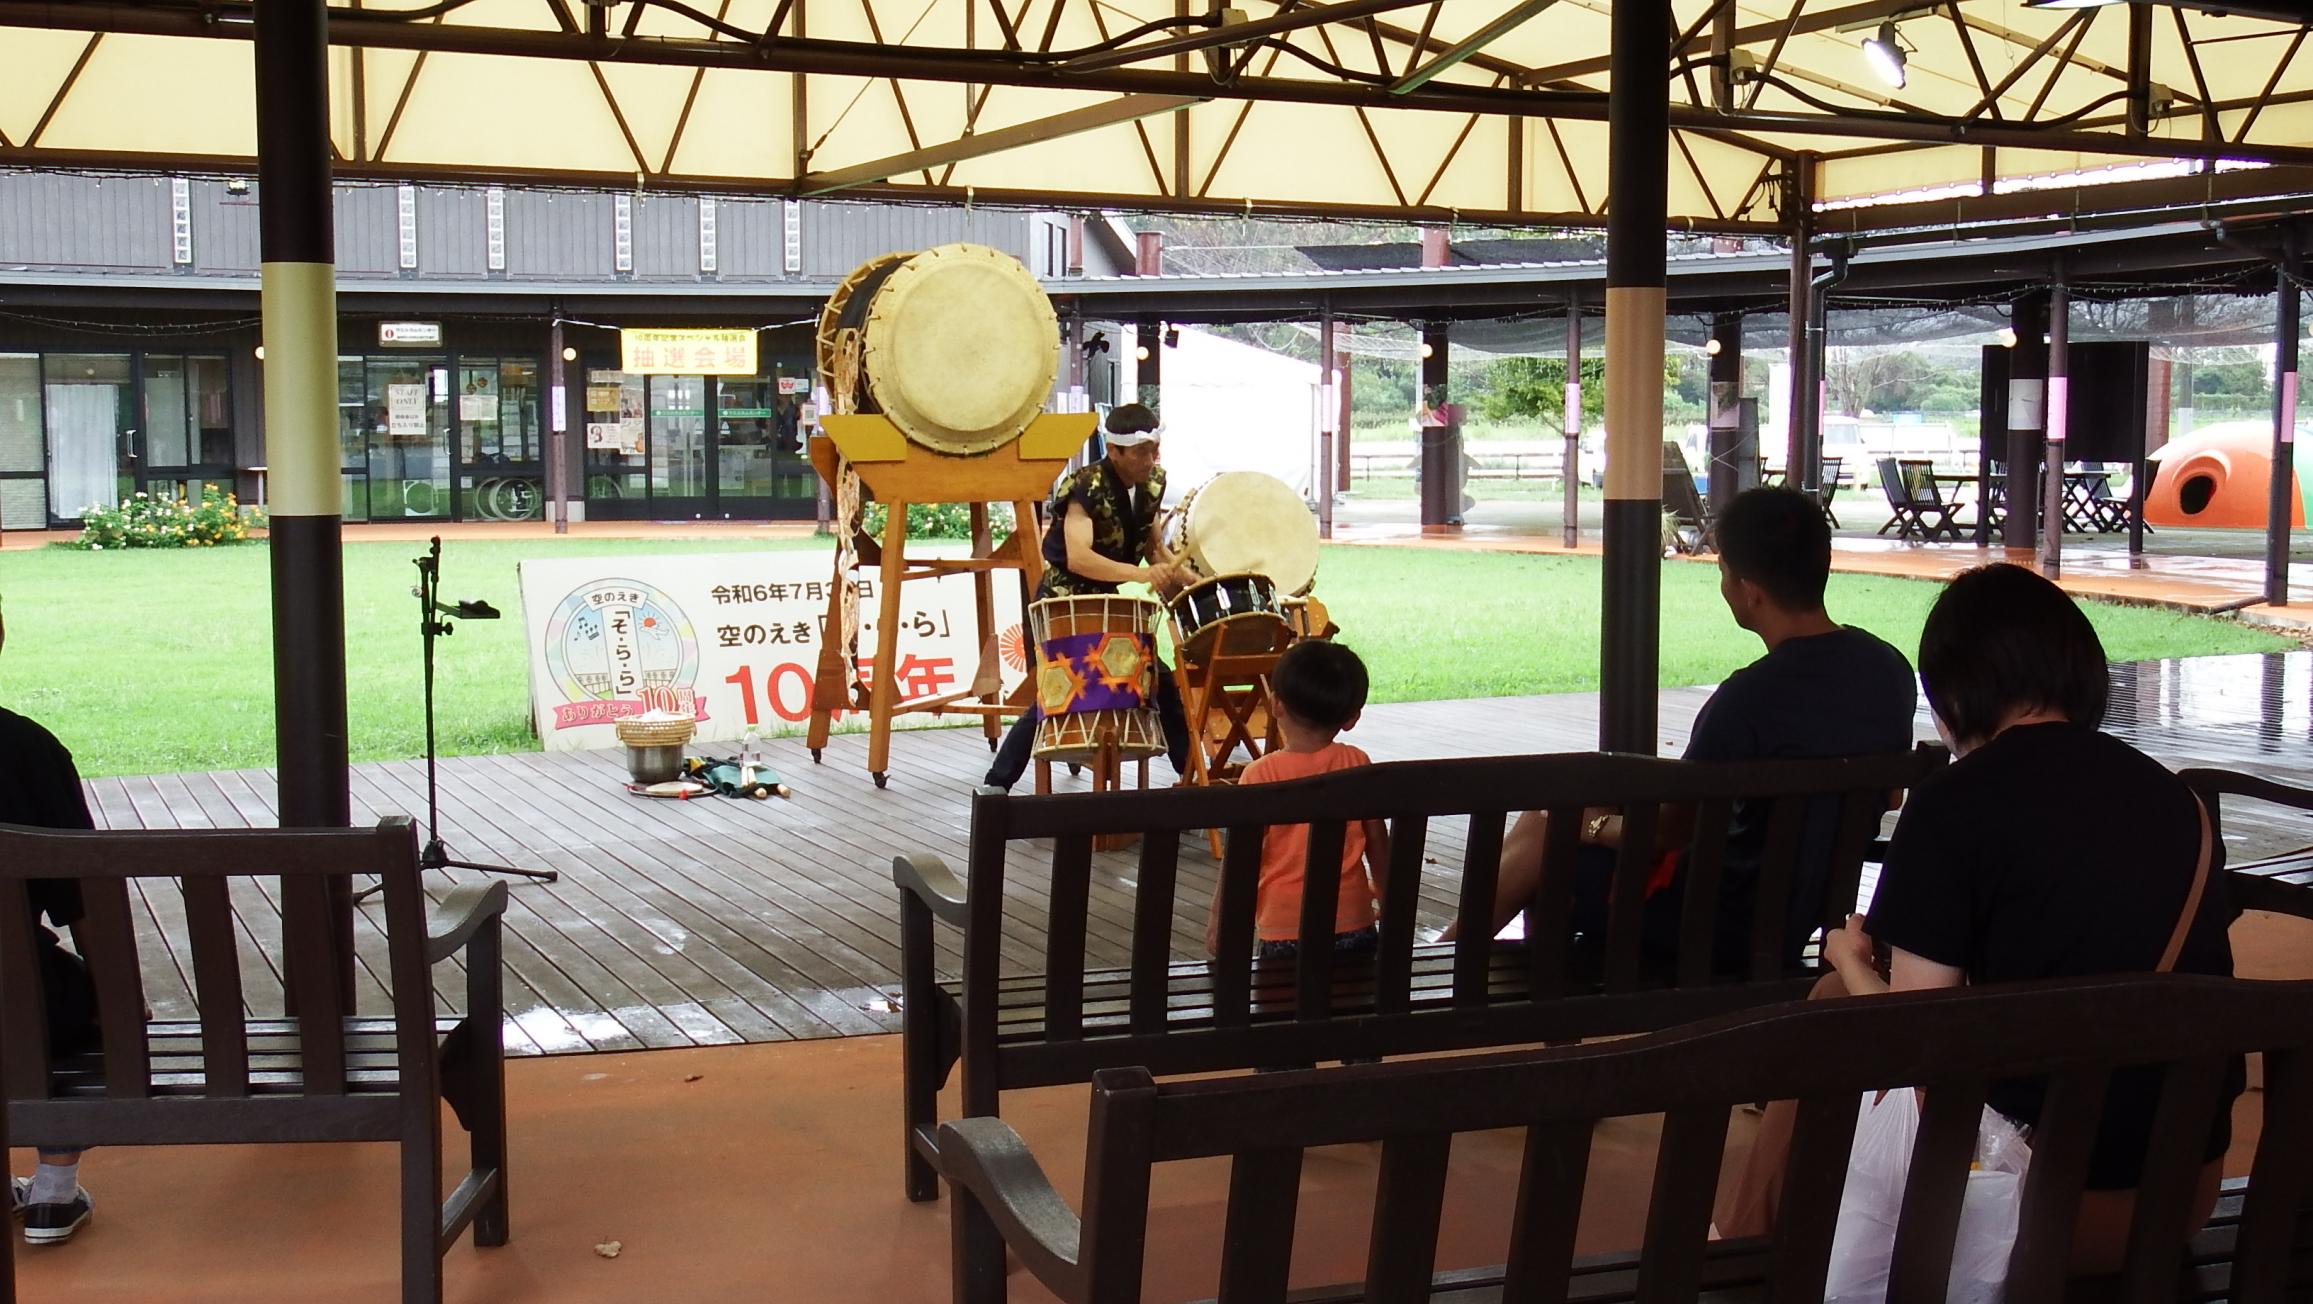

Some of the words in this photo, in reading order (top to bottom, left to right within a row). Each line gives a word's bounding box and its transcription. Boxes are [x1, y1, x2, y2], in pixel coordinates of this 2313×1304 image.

[633, 346, 746, 368] 抽選会場
[592, 592, 639, 605] 空のえき
[725, 653, 955, 725] 10年
[562, 704, 634, 722] ありがとう
